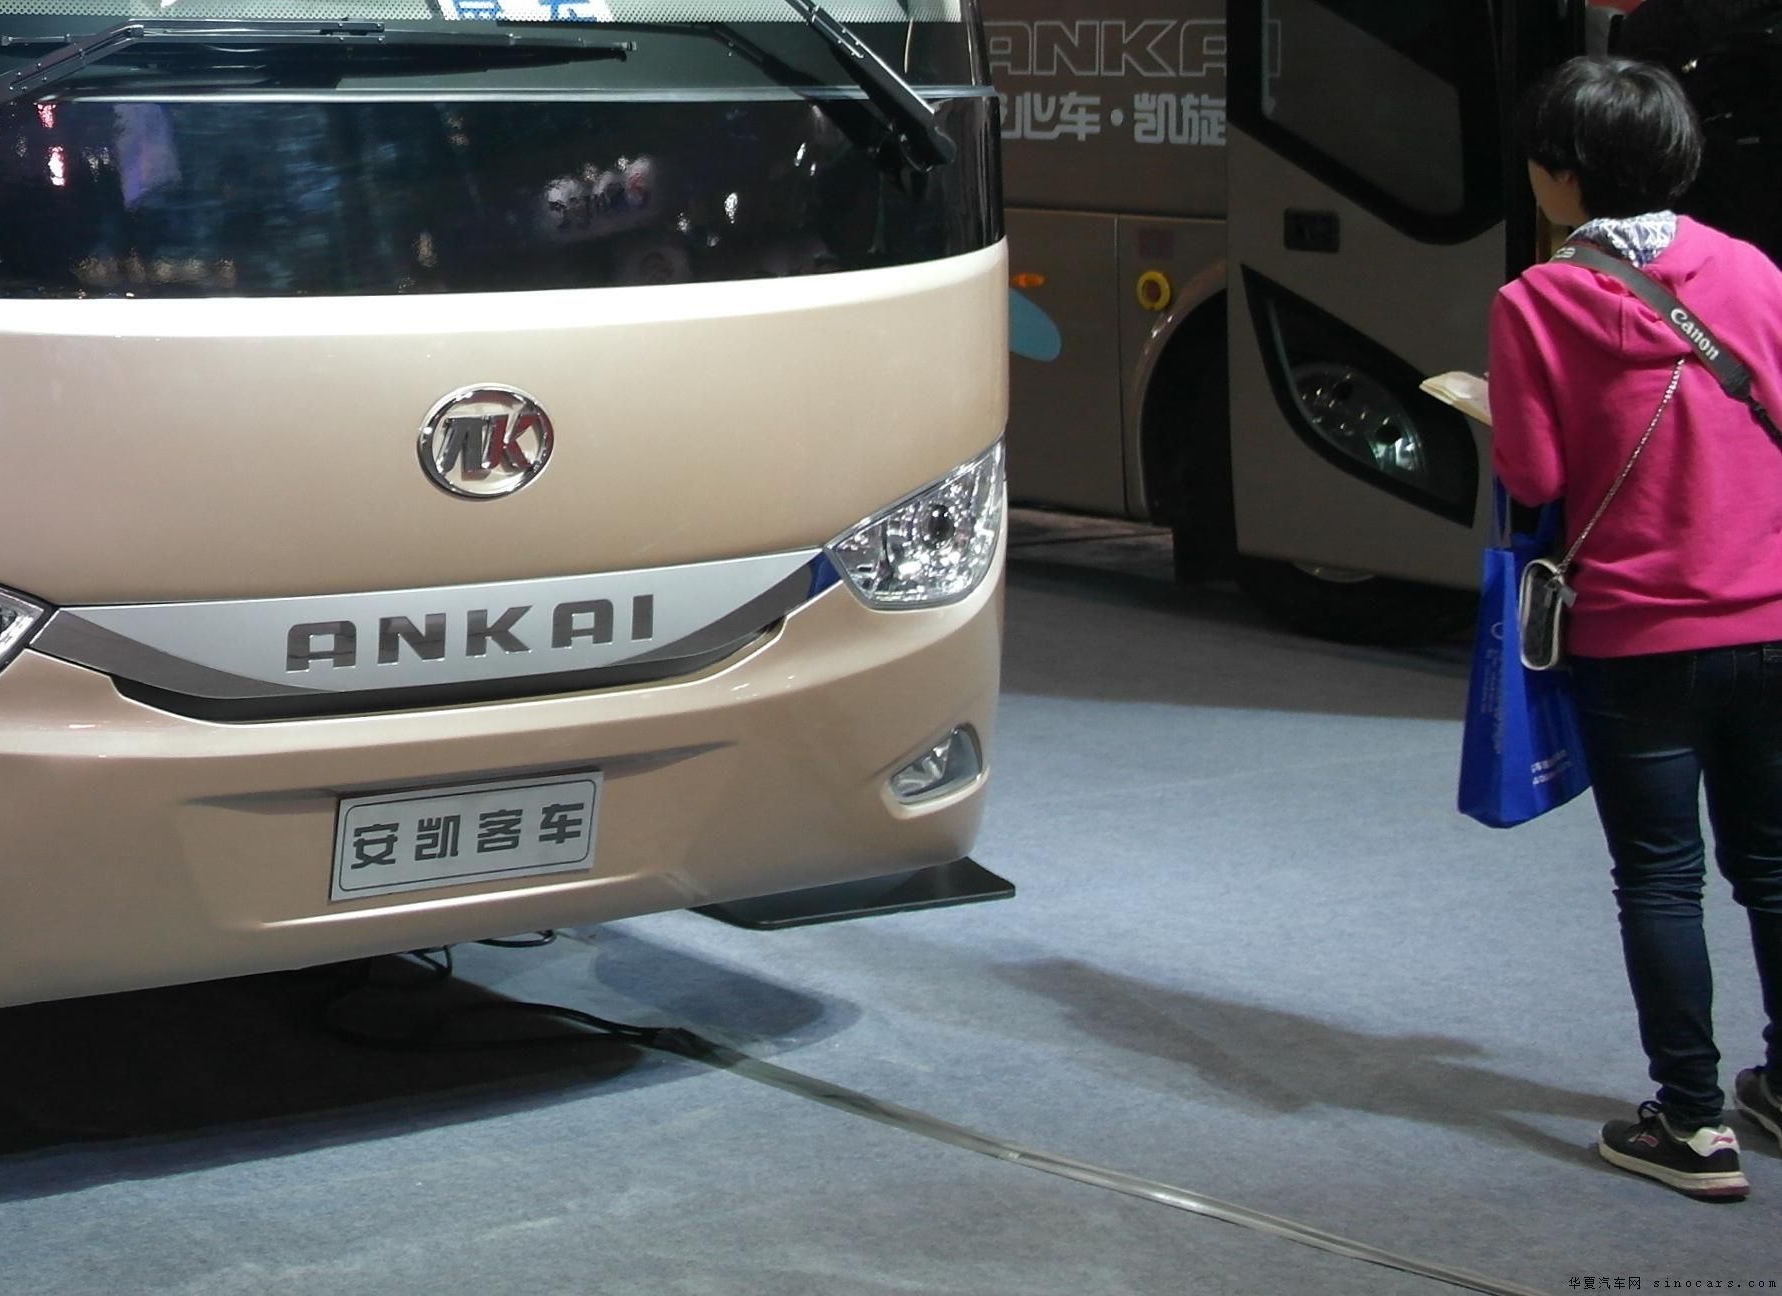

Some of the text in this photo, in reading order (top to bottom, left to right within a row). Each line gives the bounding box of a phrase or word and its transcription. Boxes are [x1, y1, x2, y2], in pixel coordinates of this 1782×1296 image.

[1669, 307, 1721, 362] Canon
[285, 593, 655, 673] ANKAI
[349, 800, 586, 870] 安凯客车
